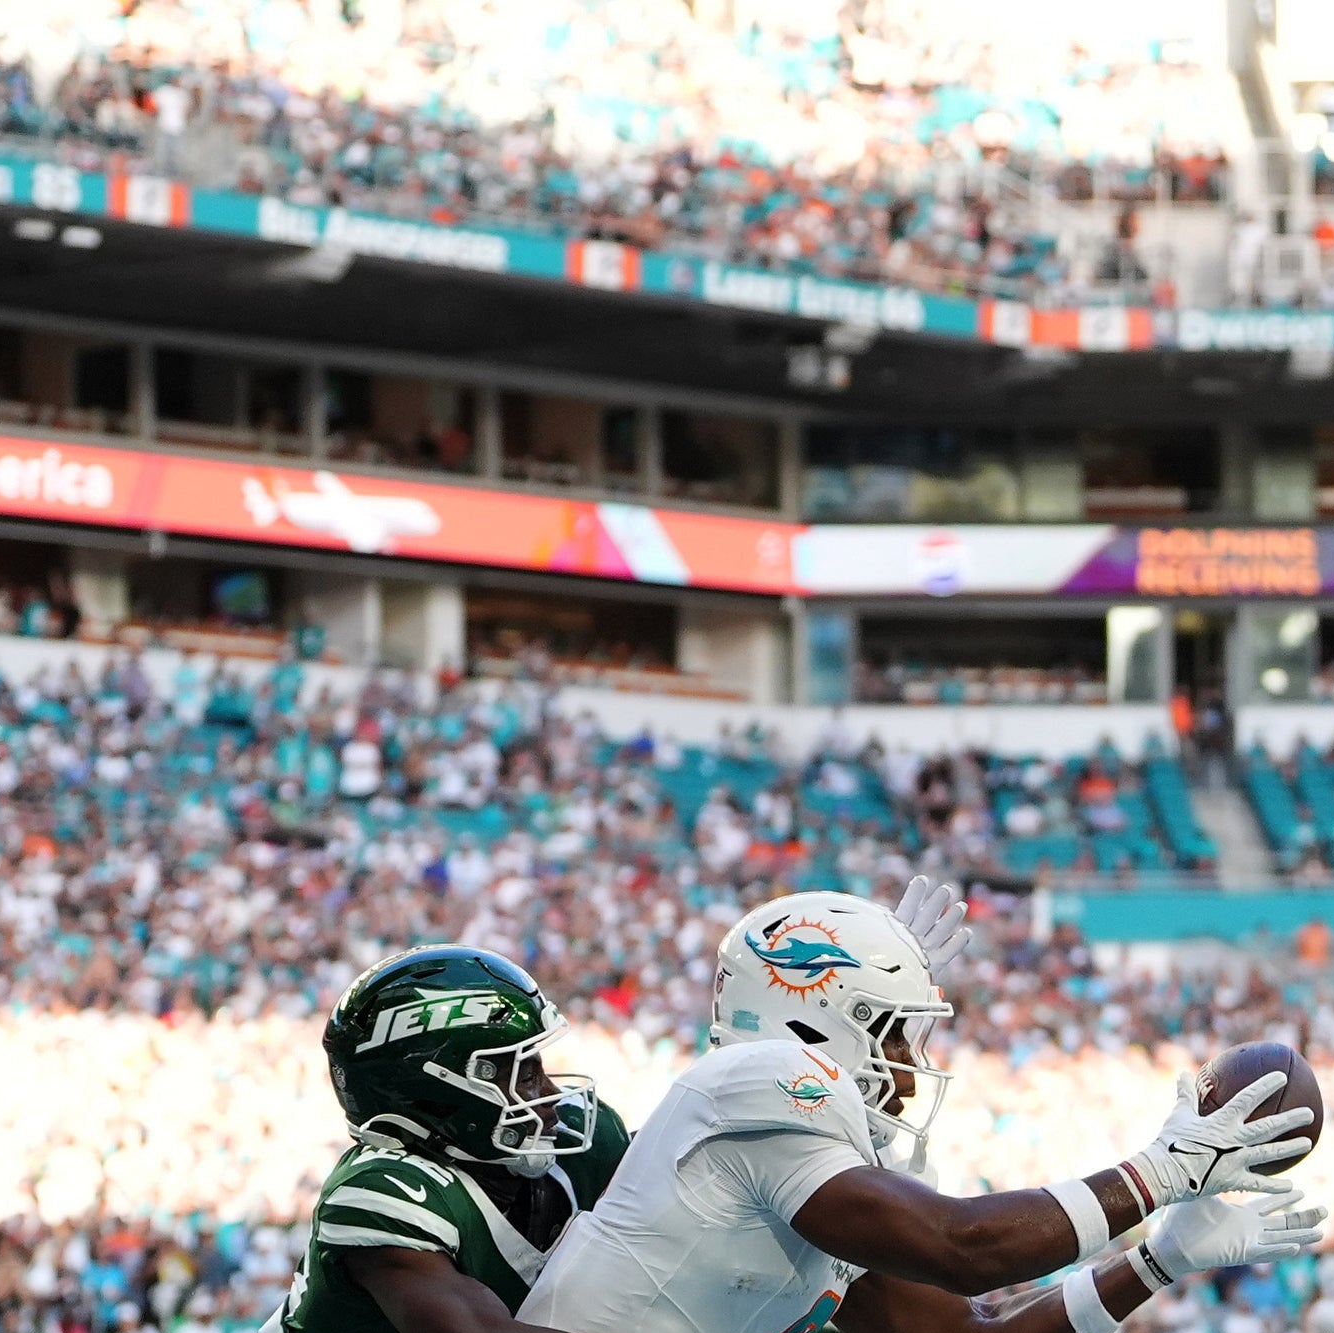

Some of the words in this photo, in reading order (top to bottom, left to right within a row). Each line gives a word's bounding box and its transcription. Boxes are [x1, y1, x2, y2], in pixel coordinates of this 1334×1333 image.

[1138, 528, 1315, 556] DOLPHINS
[1136, 561, 1321, 595] RECEIVING
[355, 994, 503, 1055] JETS
